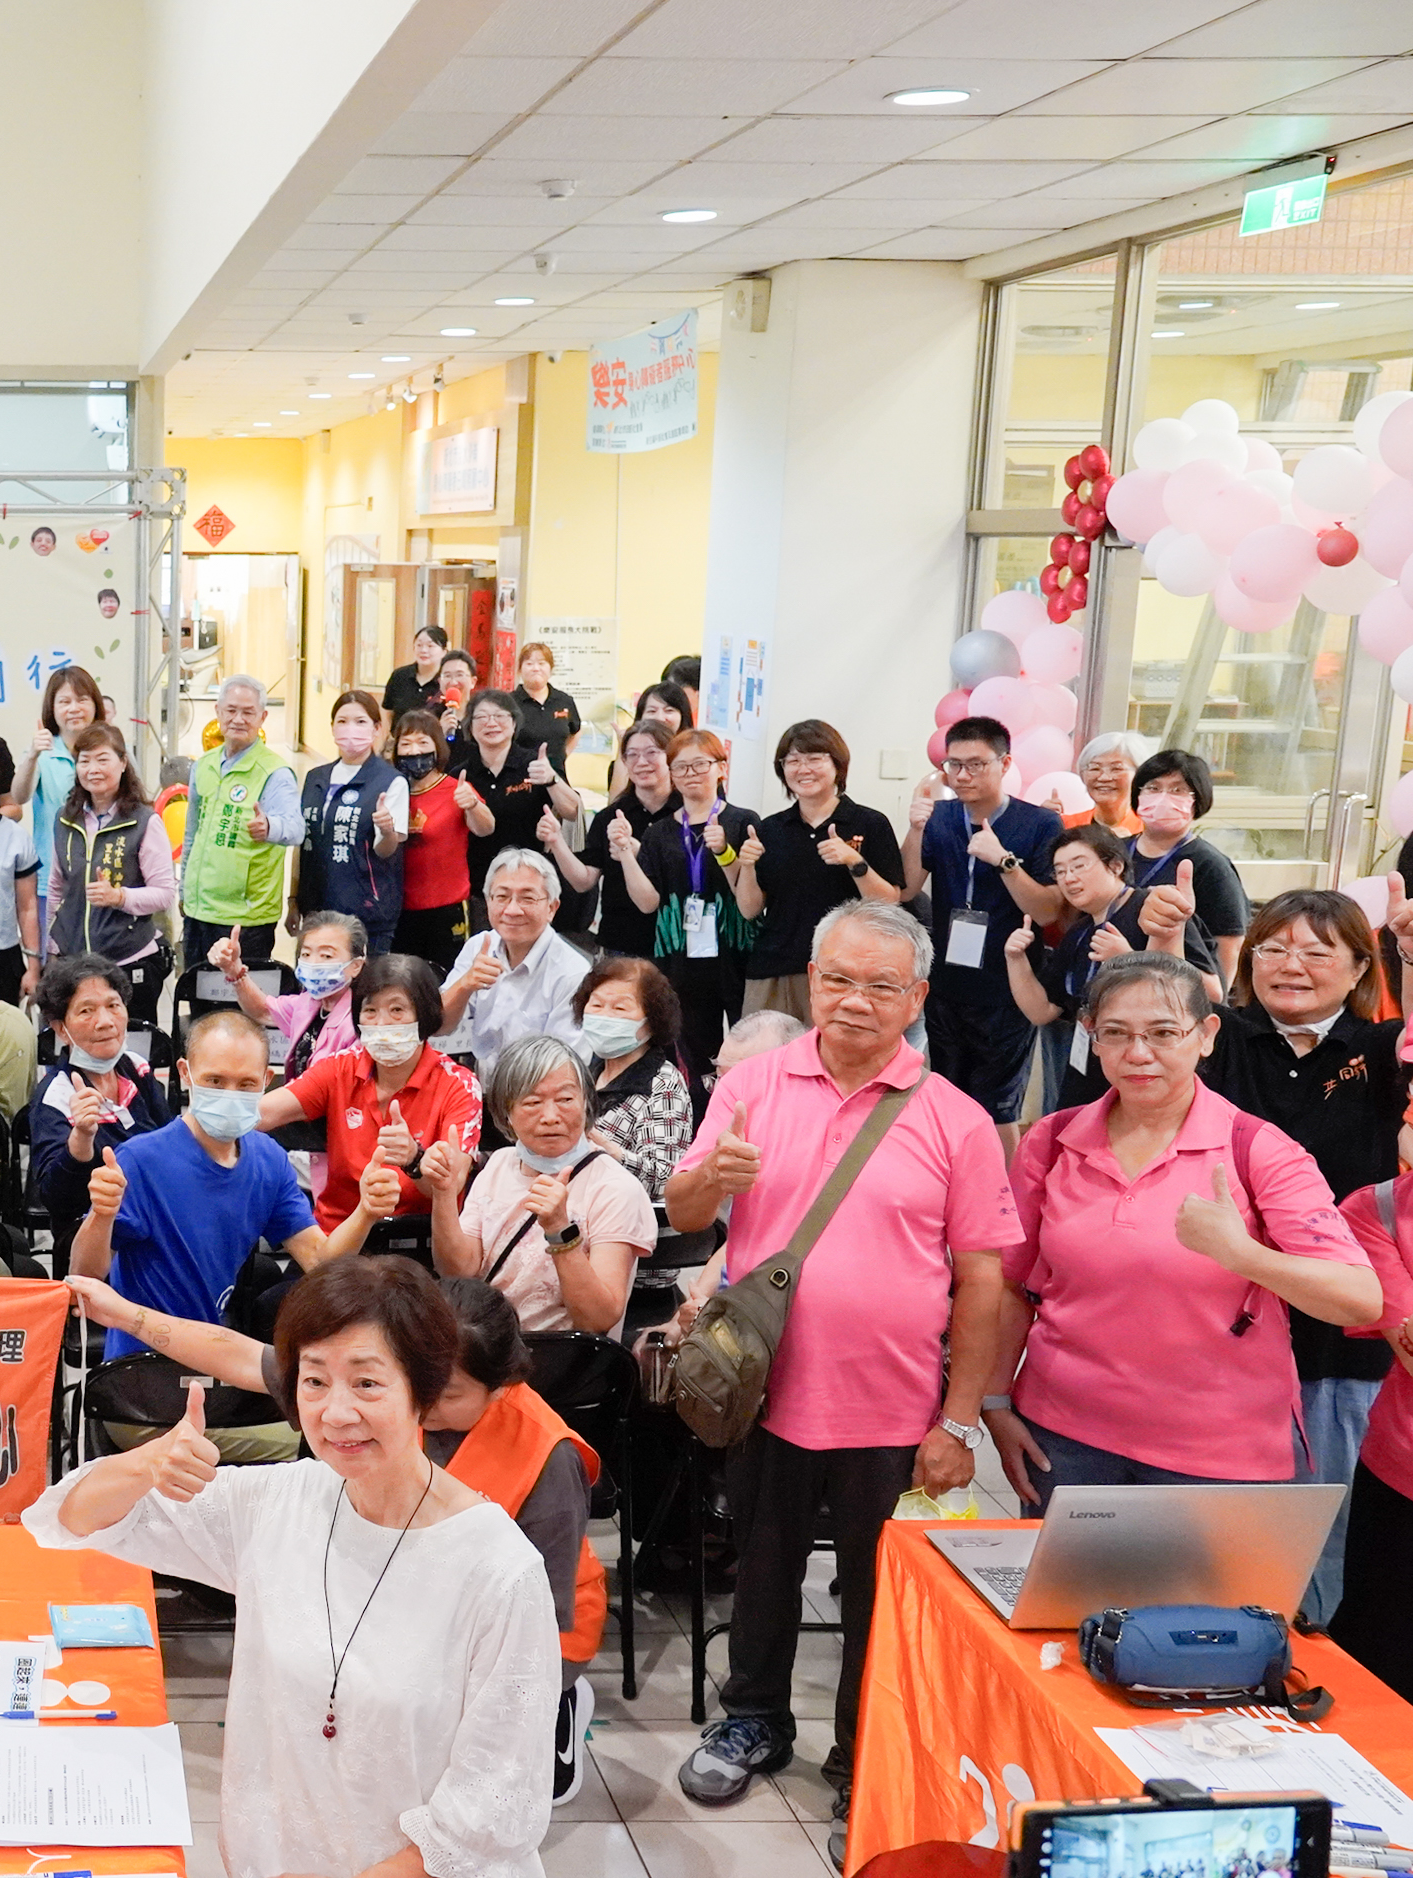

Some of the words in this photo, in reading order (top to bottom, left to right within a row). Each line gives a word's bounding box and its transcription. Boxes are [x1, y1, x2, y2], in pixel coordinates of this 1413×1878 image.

[1293, 208, 1318, 221] EXIT
[197, 510, 224, 537] 福
[1069, 1511, 1116, 1519] Lenovo
